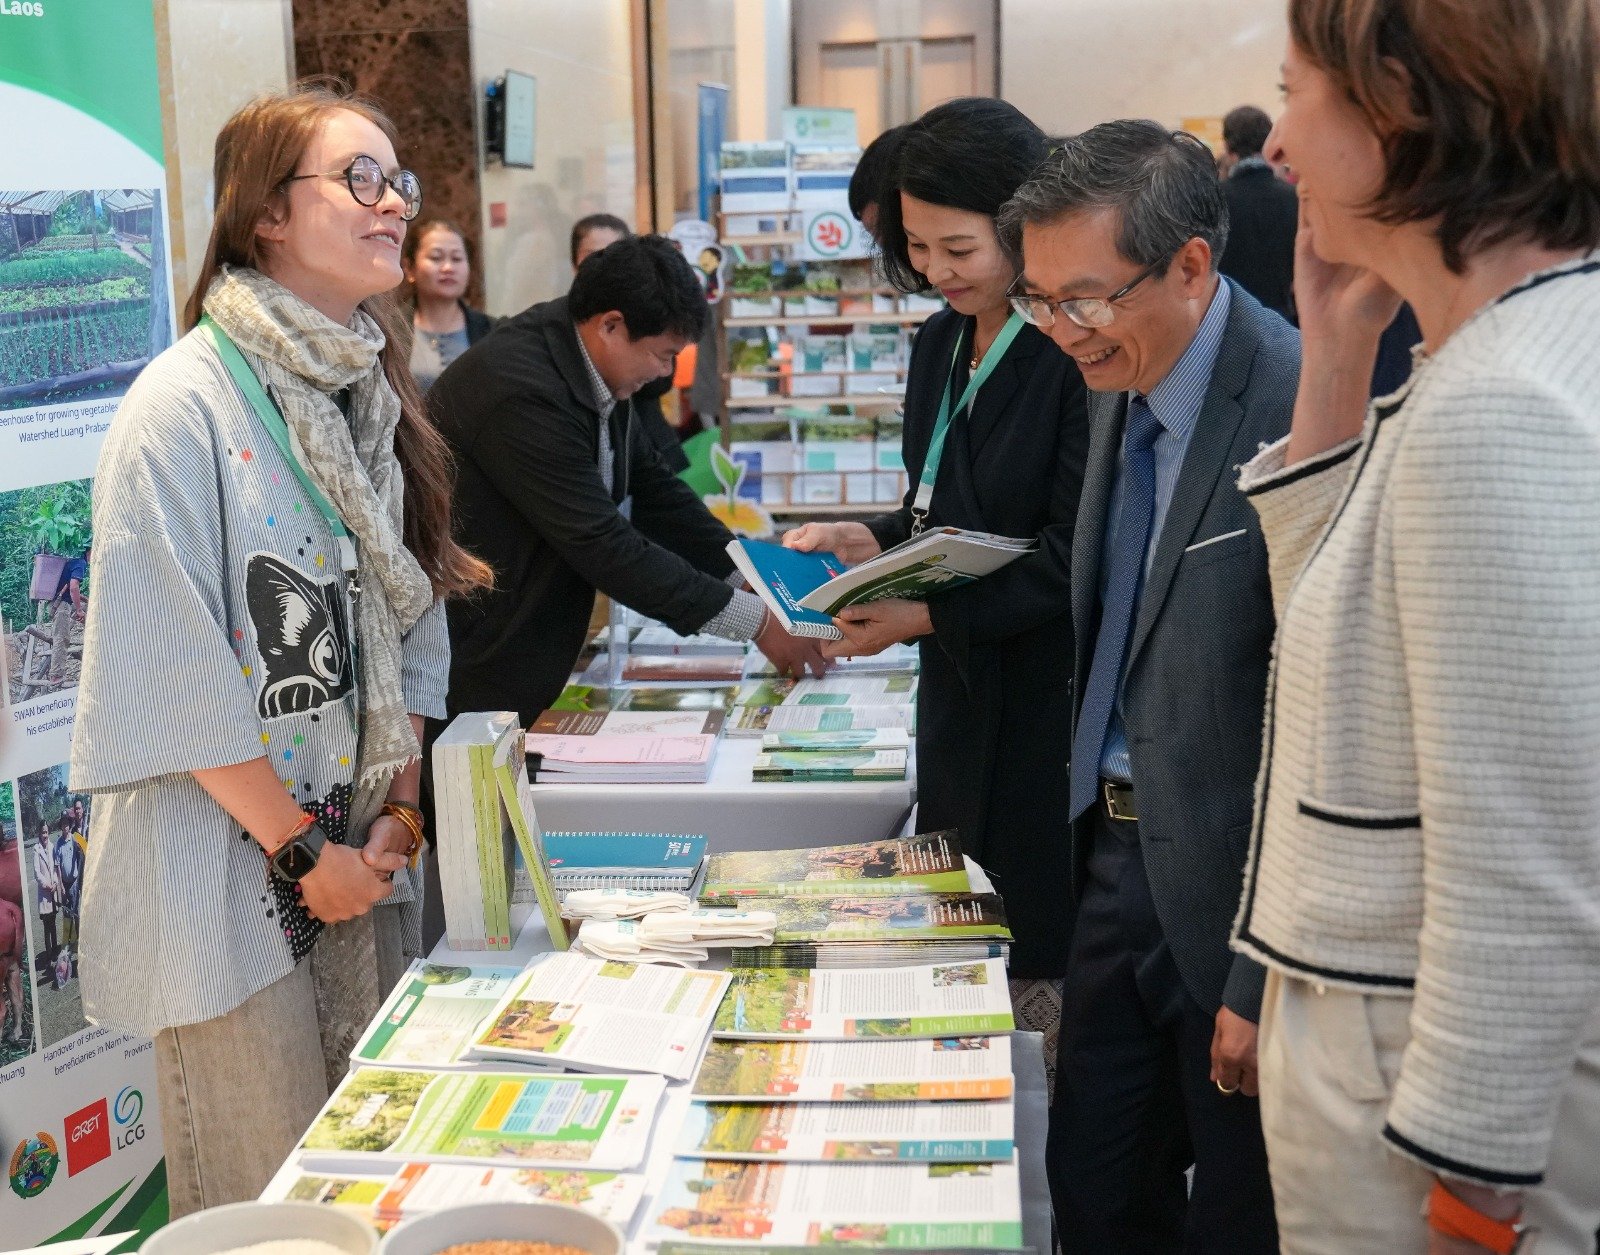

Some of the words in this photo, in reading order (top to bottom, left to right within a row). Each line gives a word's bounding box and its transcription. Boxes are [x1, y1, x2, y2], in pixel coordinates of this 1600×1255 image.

[0, 0, 44, 17] Laos
[36, 411, 46, 422] for
[49, 408, 79, 423] growing
[80, 402, 118, 418] vegetables
[19, 428, 59, 442] Watershed
[60, 427, 84, 438] Luang
[14, 706, 36, 722] SWAN
[36, 698, 74, 715] beneficiary
[26, 725, 37, 736] his
[44, 1041, 76, 1063] Handover
[77, 1034, 84, 1047] of
[54, 1049, 97, 1076] beneficiaries
[97, 1045, 104, 1055] in
[105, 1037, 122, 1051] Nam
[124, 1041, 153, 1060] Province
[0, 1066, 25, 1084] huang
[72, 1112, 101, 1143] GRET
[116, 1123, 145, 1150] LCG
